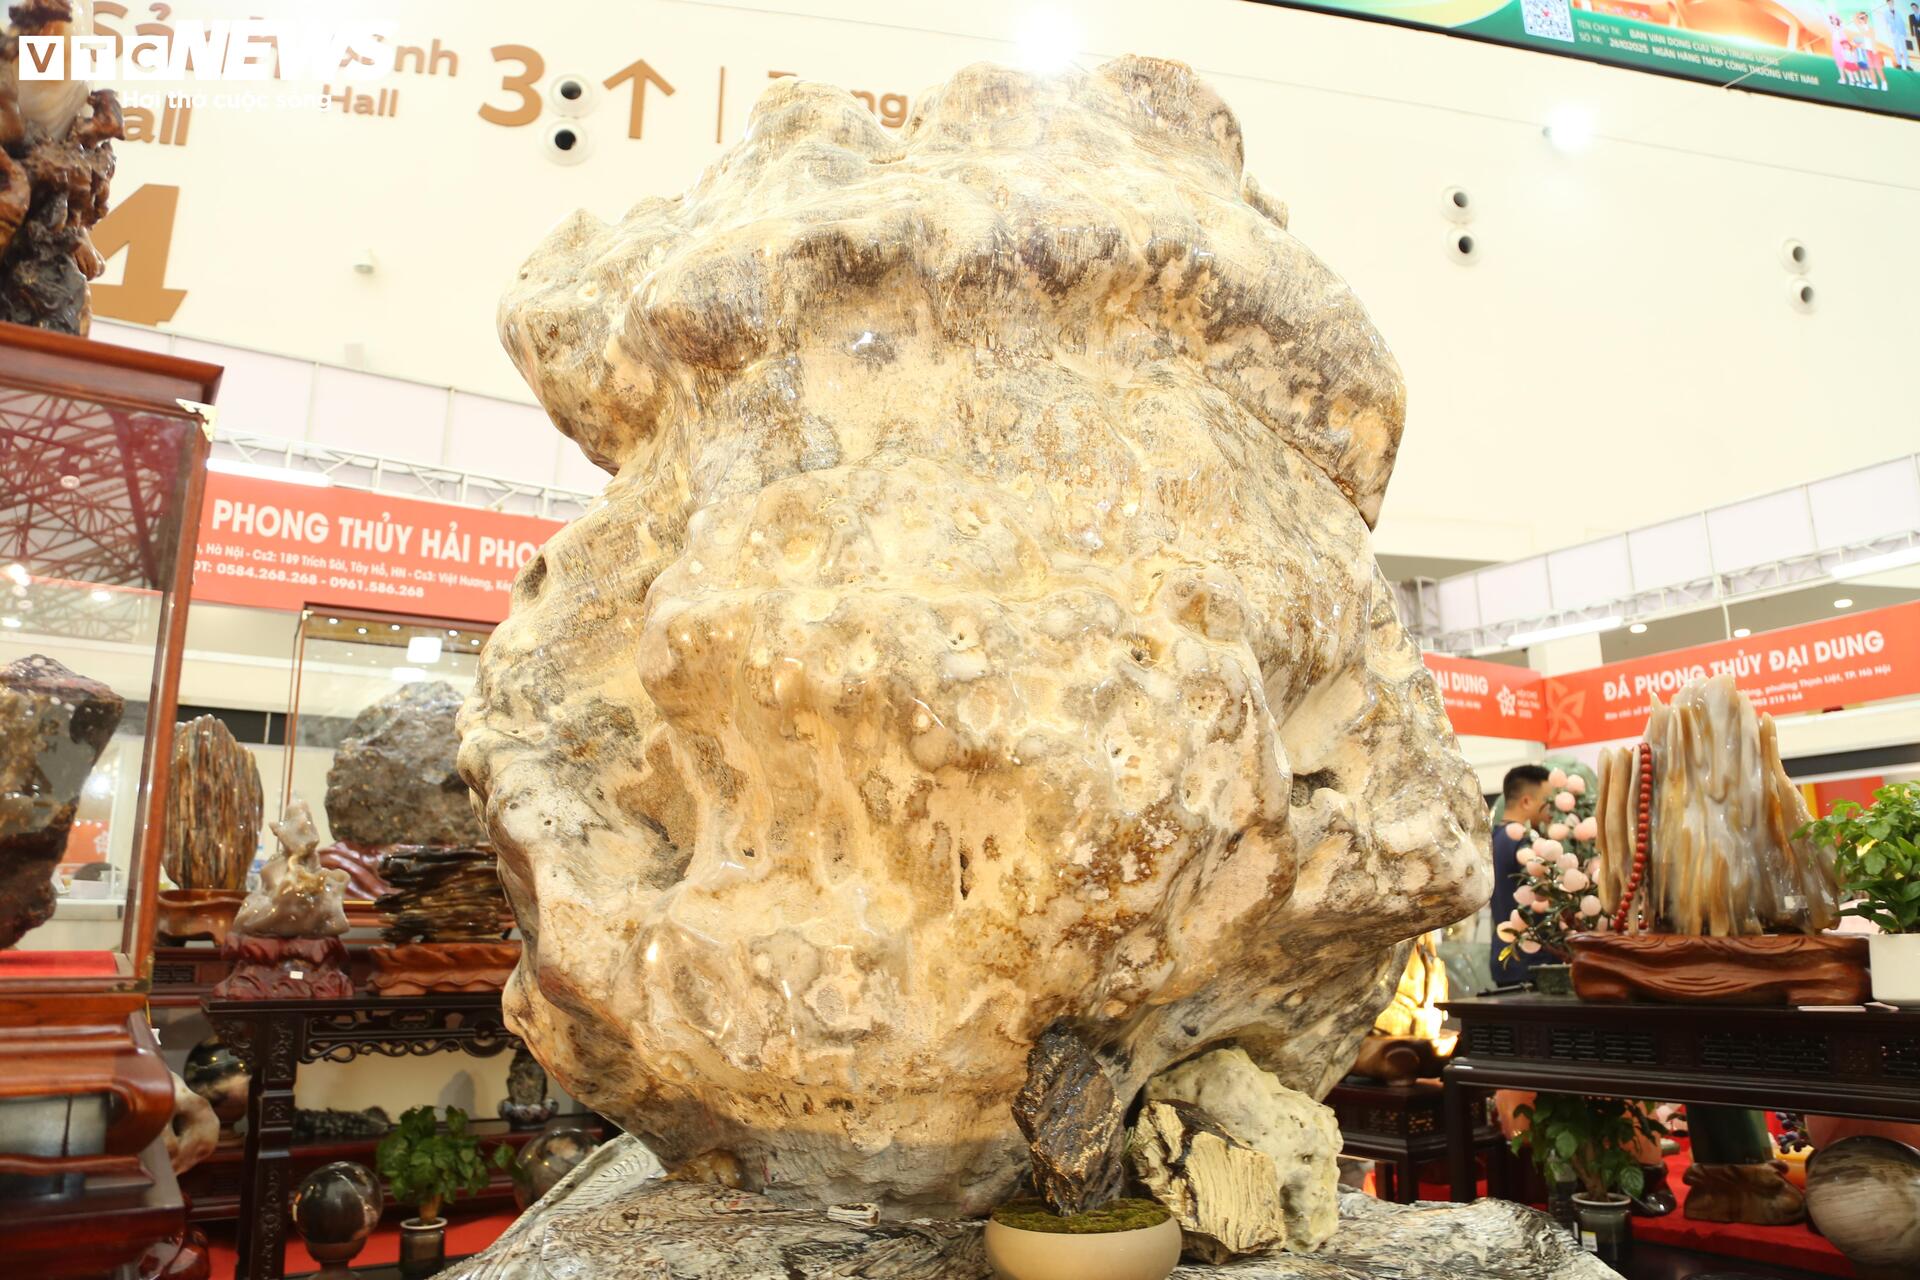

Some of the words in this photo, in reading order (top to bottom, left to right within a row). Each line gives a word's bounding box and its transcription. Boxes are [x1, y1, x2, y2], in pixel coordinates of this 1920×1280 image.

[477, 44, 546, 128] 3
[121, 95, 192, 146] all
[212, 498, 330, 543] PHONG
[338, 511, 414, 555] THỦY
[420, 521, 471, 563] HẢI
[478, 535, 541, 570] PHO
[206, 543, 222, 556] Hà
[225, 545, 244, 560] Nội
[280, 552, 300, 565] 189
[302, 554, 326, 568] Trích
[390, 566, 407, 578] HN
[216, 562, 318, 586] 0584.268.268
[330, 576, 424, 598] 0961.586.268
[1451, 672, 1489, 696] DUNG
[1603, 673, 1631, 702] ĐÁ
[1634, 665, 1706, 696] PHONG
[1710, 649, 1762, 678] THỦY
[1768, 644, 1808, 674] ĐẠI
[1814, 630, 1885, 664] DUNG
